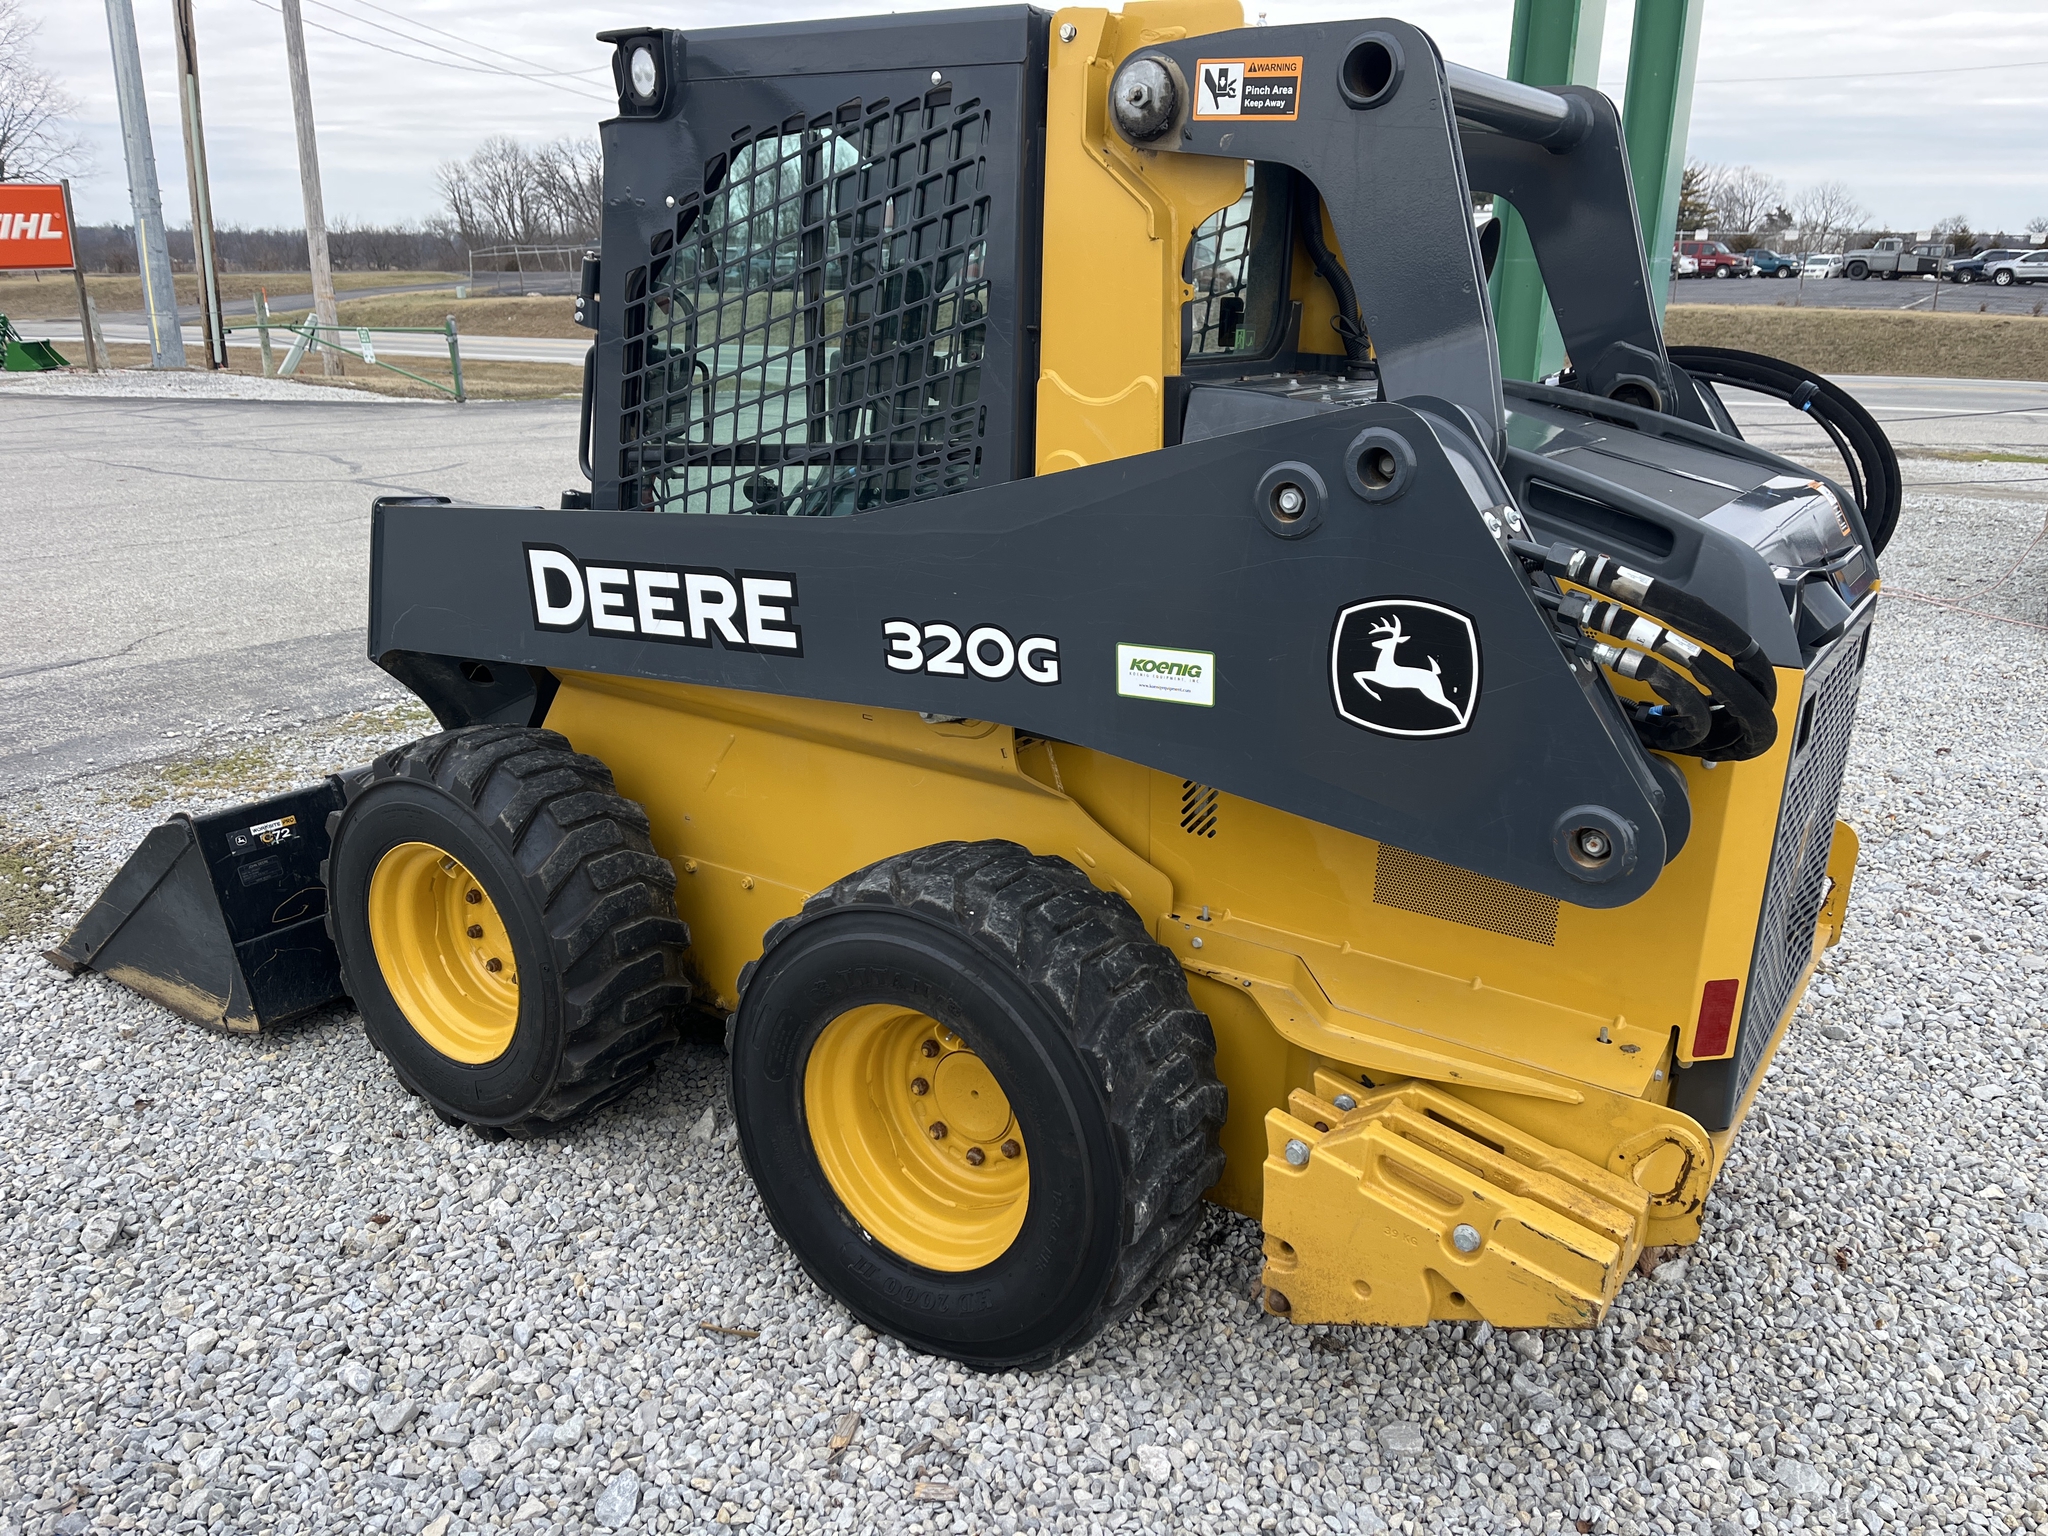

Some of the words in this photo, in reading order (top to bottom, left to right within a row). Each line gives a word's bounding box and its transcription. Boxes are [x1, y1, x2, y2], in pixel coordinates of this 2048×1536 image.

[1256, 62, 1297, 72] WARNING
[1245, 85, 1271, 95] Pinch
[1271, 85, 1294, 95] Area
[1244, 98, 1264, 109] Keep
[1264, 98, 1286, 109] Away
[0, 212, 64, 240] IHL
[527, 548, 799, 649] DEERE
[884, 620, 1060, 684] 320G
[252, 821, 281, 833] WORKSITE
[282, 817, 295, 825] PRO
[1382, 1225, 1400, 1240] 39
[1402, 1231, 1420, 1247] KG
